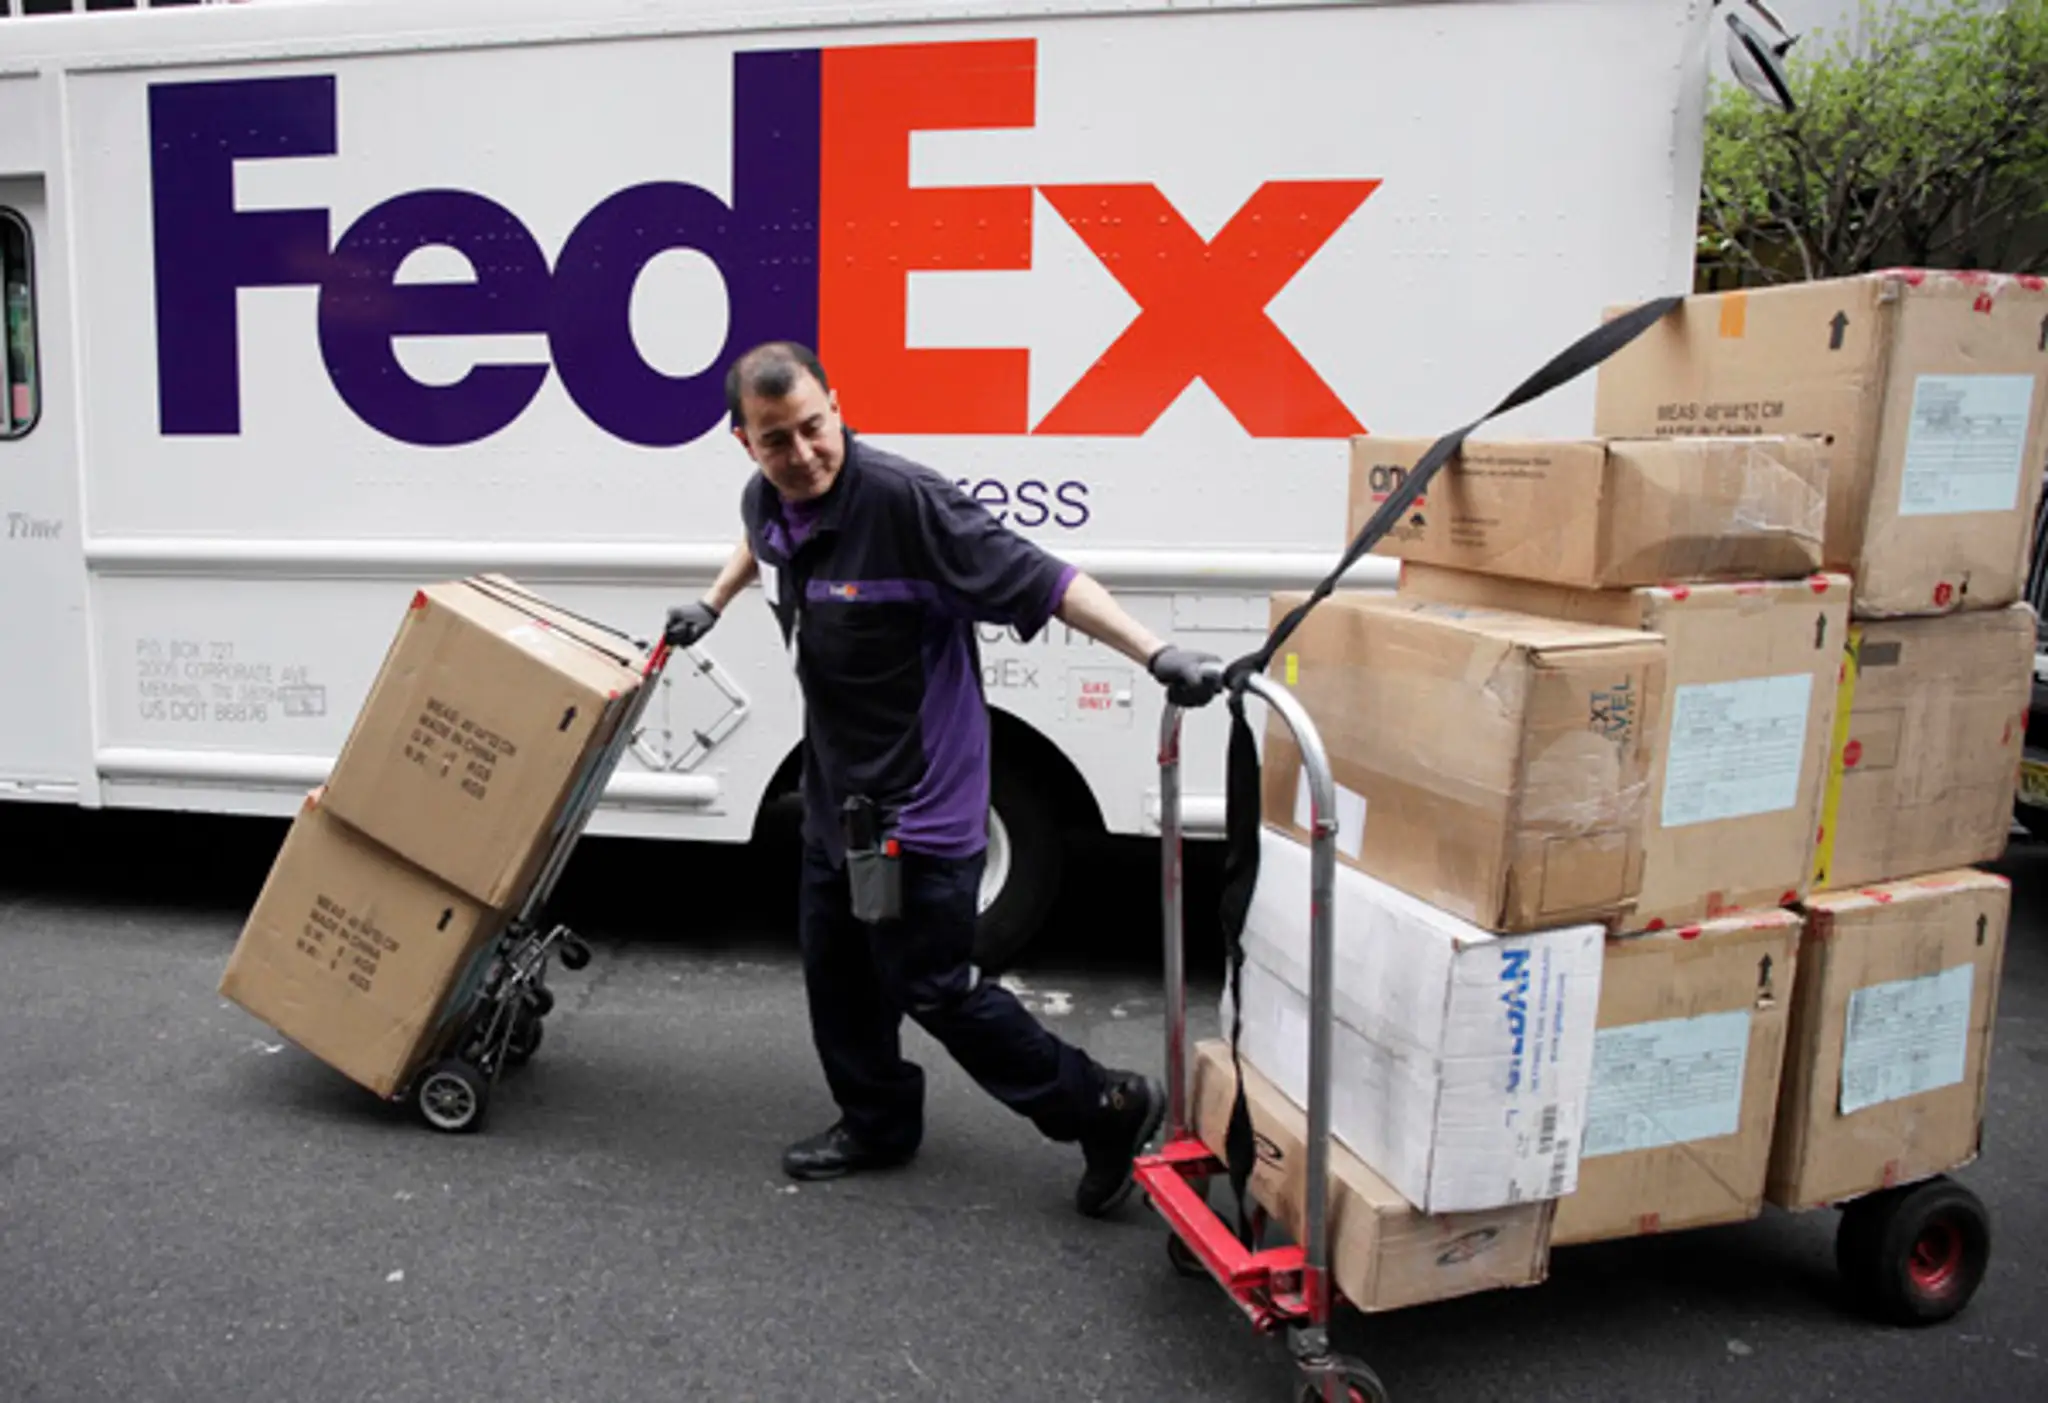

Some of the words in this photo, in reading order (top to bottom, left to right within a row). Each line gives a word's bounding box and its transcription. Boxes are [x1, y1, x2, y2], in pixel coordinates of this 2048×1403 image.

[148, 38, 1383, 447] FedEx
[957, 478, 1091, 528] ess
[7, 511, 63, 539] Time
[170, 701, 207, 722] DOT
[1077, 696, 1112, 710] ONLY
